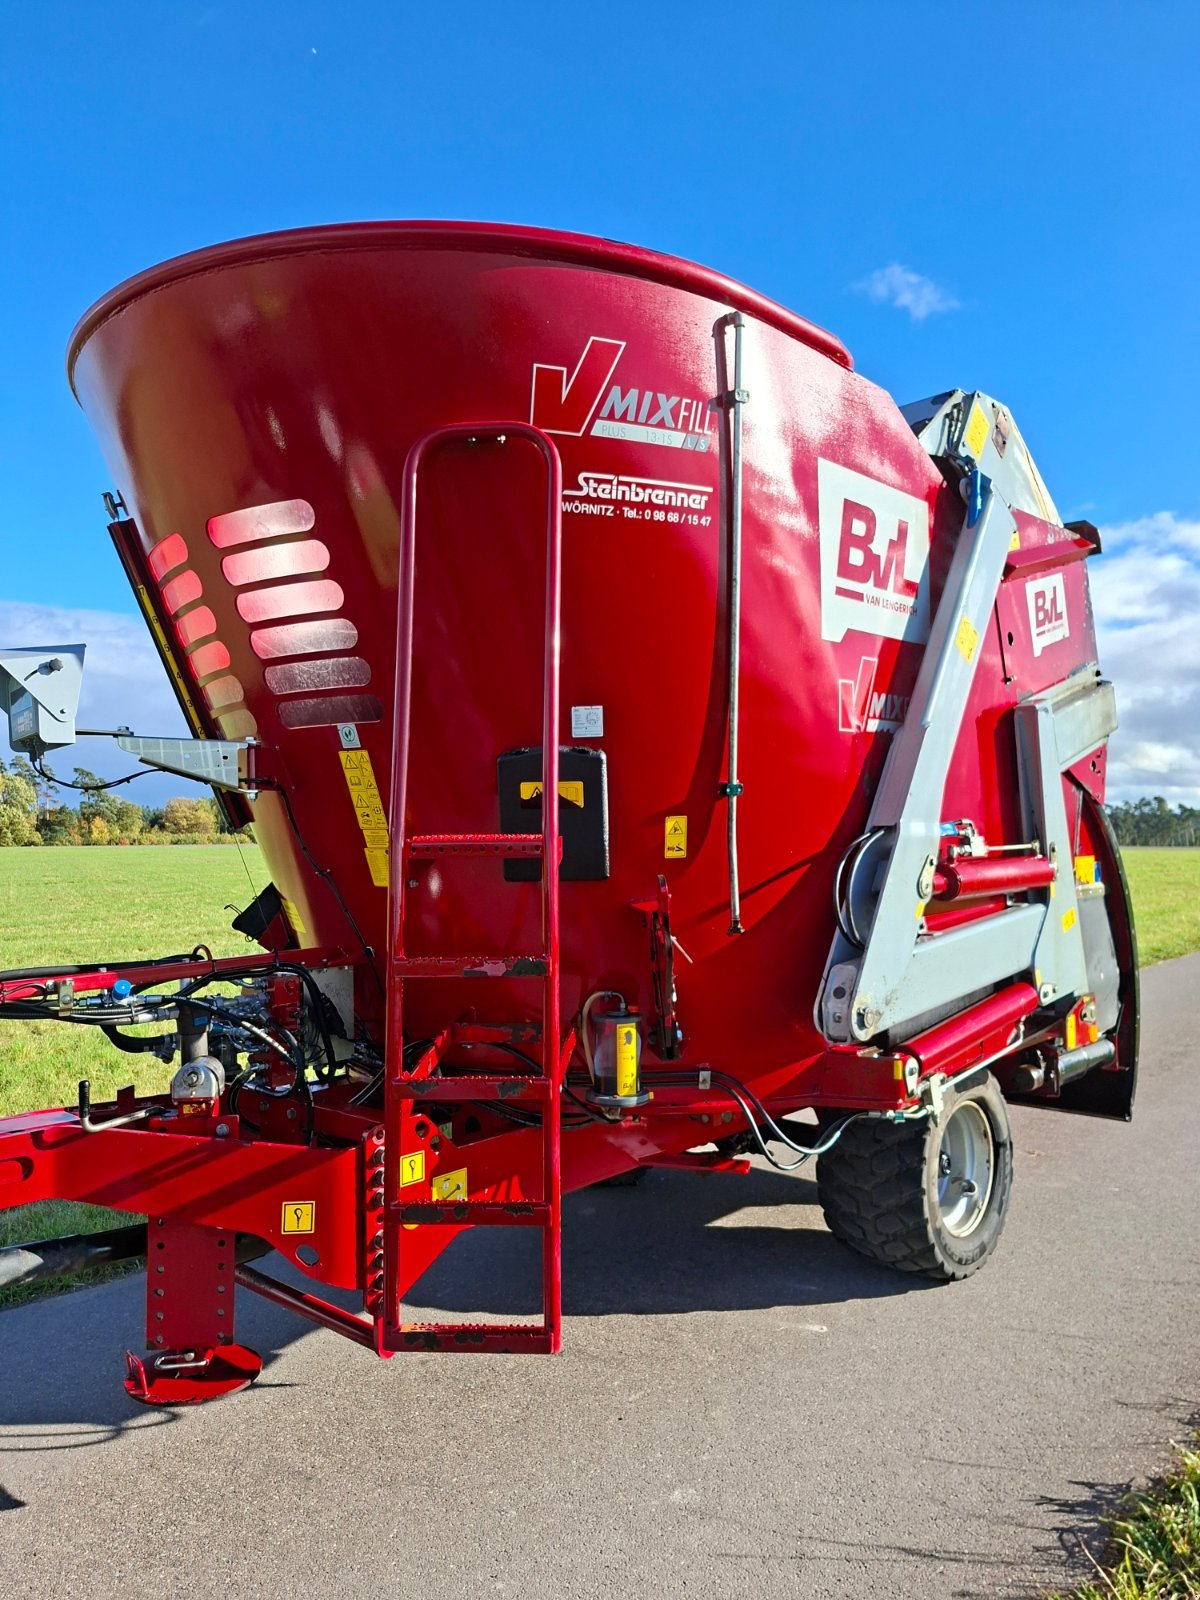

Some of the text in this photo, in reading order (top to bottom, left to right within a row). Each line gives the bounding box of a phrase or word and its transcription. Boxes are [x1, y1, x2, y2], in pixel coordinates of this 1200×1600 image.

[601, 423, 626, 438] PLUS
[562, 472, 714, 510] Steinbrenner
[561, 501, 614, 517] WÖRNITZ
[622, 507, 642, 519] Tel.:
[653, 510, 665, 521] 98
[667, 512, 679, 523] 68
[687, 514, 699, 526] 15
[700, 516, 712, 527] 47
[866, 594, 880, 607] VAN
